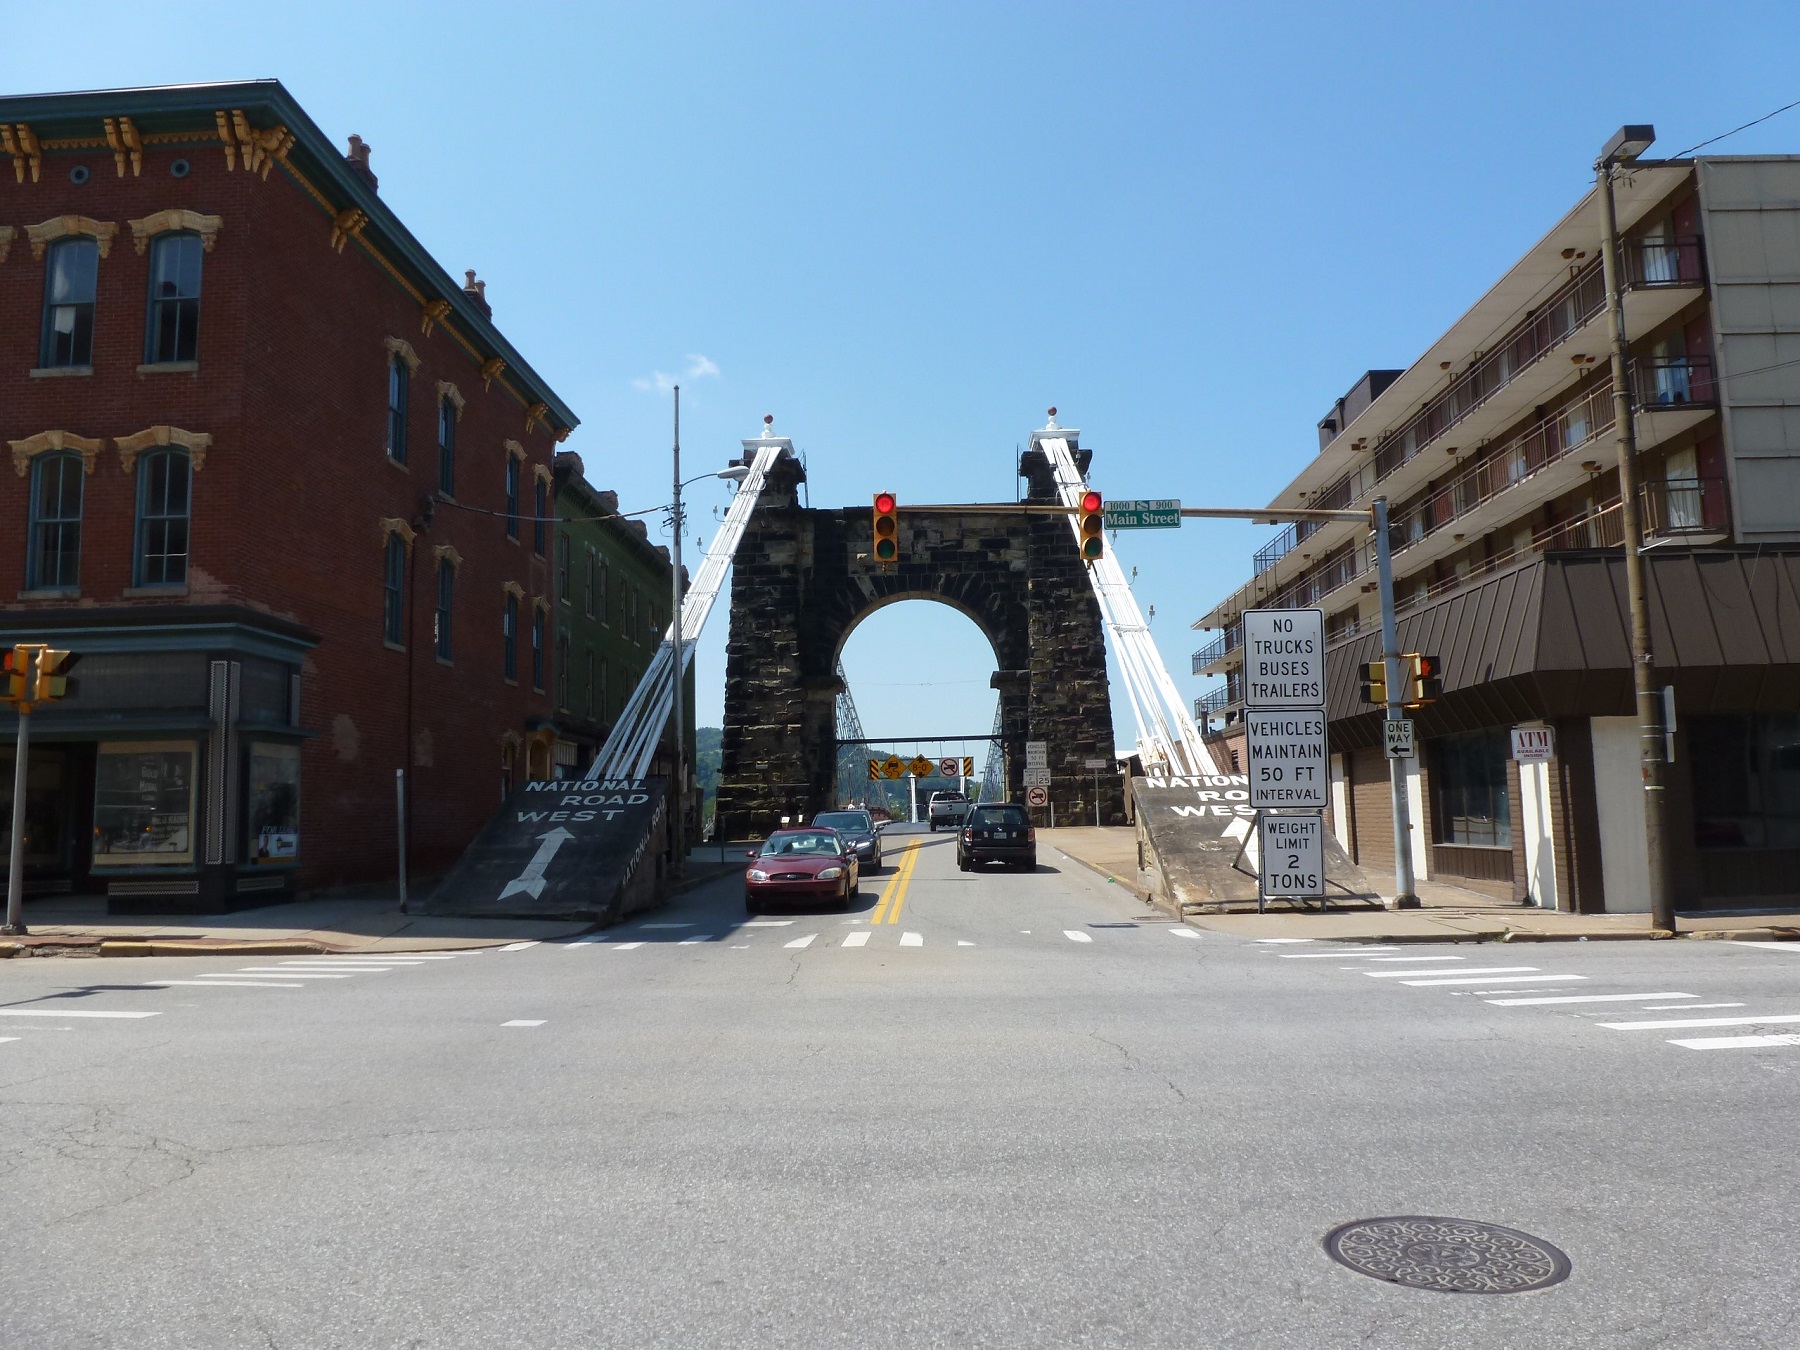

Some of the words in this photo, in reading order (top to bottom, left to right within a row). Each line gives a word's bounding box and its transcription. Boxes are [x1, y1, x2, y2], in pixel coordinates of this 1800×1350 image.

[1110, 502, 1130, 510] 1000
[1156, 501, 1172, 509] 900
[1106, 513, 1137, 525] Main
[1142, 512, 1178, 524] Street
[1273, 618, 1293, 633] NO
[1254, 640, 1314, 655] TRUCKS
[1260, 662, 1309, 676] BUSES
[1252, 682, 1319, 698] TRAILERS
[1250, 720, 1323, 737] VEHICLES
[1388, 723, 1410, 732] ONE
[1388, 734, 1411, 743] WAY
[1518, 732, 1548, 748] ATM
[1252, 744, 1322, 759] MAINTAIN
[1261, 768, 1283, 782] 50
[1295, 767, 1315, 781] FT
[525, 780, 647, 792] NATIONAL
[1146, 775, 1248, 788] NATION
[560, 794, 650, 806] ROAD
[1197, 790, 1249, 802] RO
[1256, 789, 1320, 801] INTERVAL
[517, 810, 624, 822] WEST
[1170, 804, 1278, 817] WES
[1268, 823, 1316, 835] WEIGHT
[1276, 838, 1310, 850] LIMIT
[1288, 854, 1299, 869] 2
[1270, 874, 1317, 888] TONS
